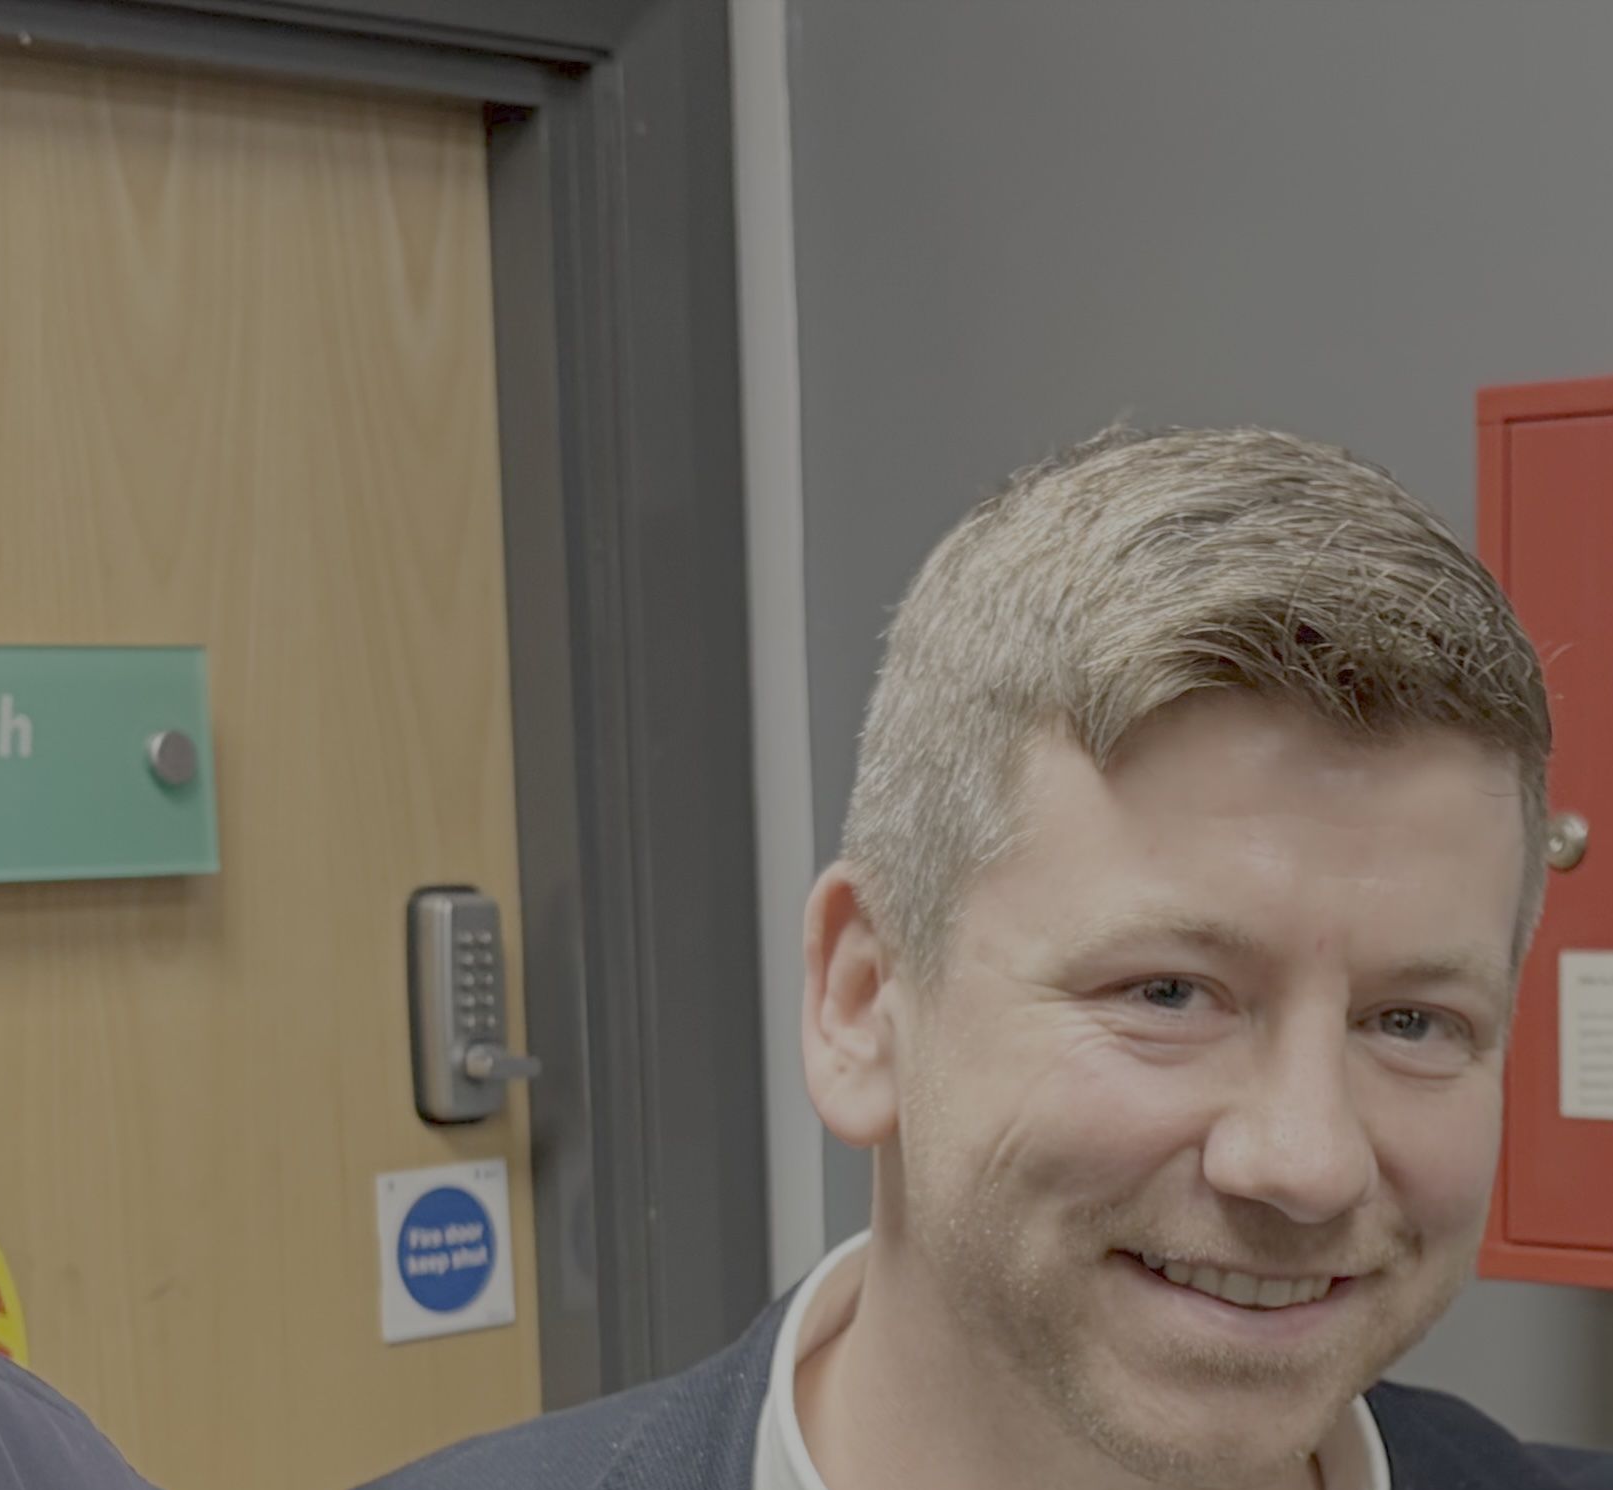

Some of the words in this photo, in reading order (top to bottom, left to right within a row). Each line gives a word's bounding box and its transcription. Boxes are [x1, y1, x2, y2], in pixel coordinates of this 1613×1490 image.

[408, 1226, 443, 1250] Fire
[443, 1221, 484, 1247] door
[407, 1251, 451, 1278] keep
[451, 1243, 488, 1271] shut
